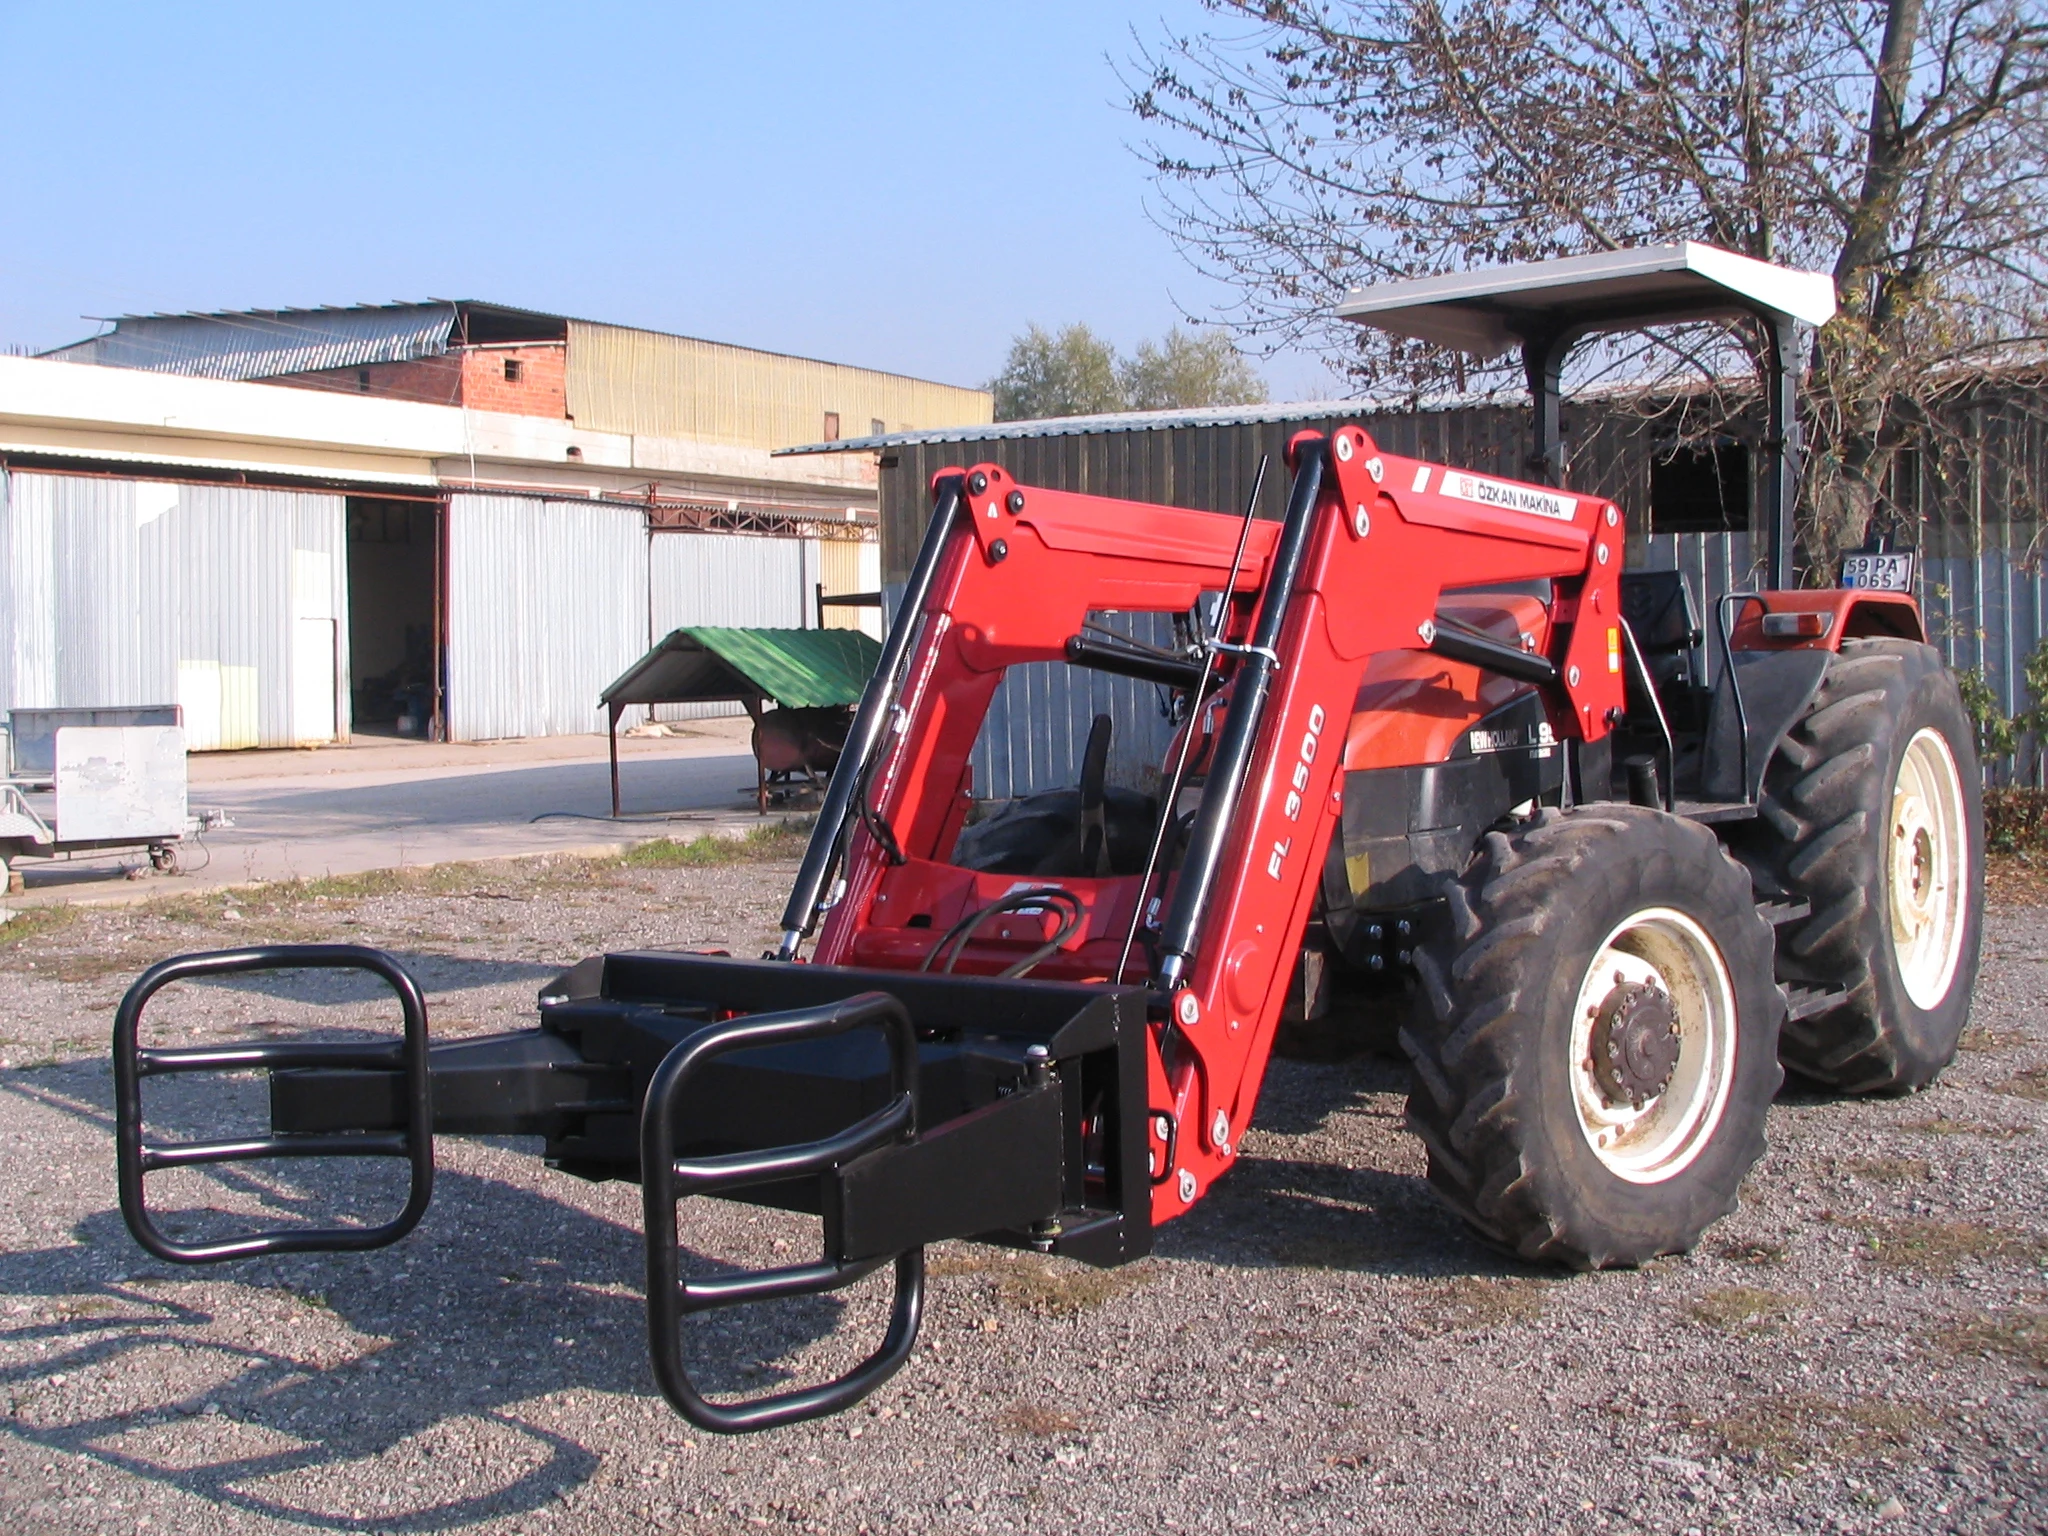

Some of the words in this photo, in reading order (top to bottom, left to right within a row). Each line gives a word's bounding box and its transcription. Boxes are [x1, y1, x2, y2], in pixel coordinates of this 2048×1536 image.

[1478, 481, 1517, 507] ÖZKAN
[1519, 493, 1561, 516] MAKİNA
[1848, 558, 1869, 574] 59
[1875, 558, 1898, 574] PA
[1857, 574, 1892, 588] 065
[1267, 836, 1291, 881] FL
[1285, 703, 1326, 822] 3500
